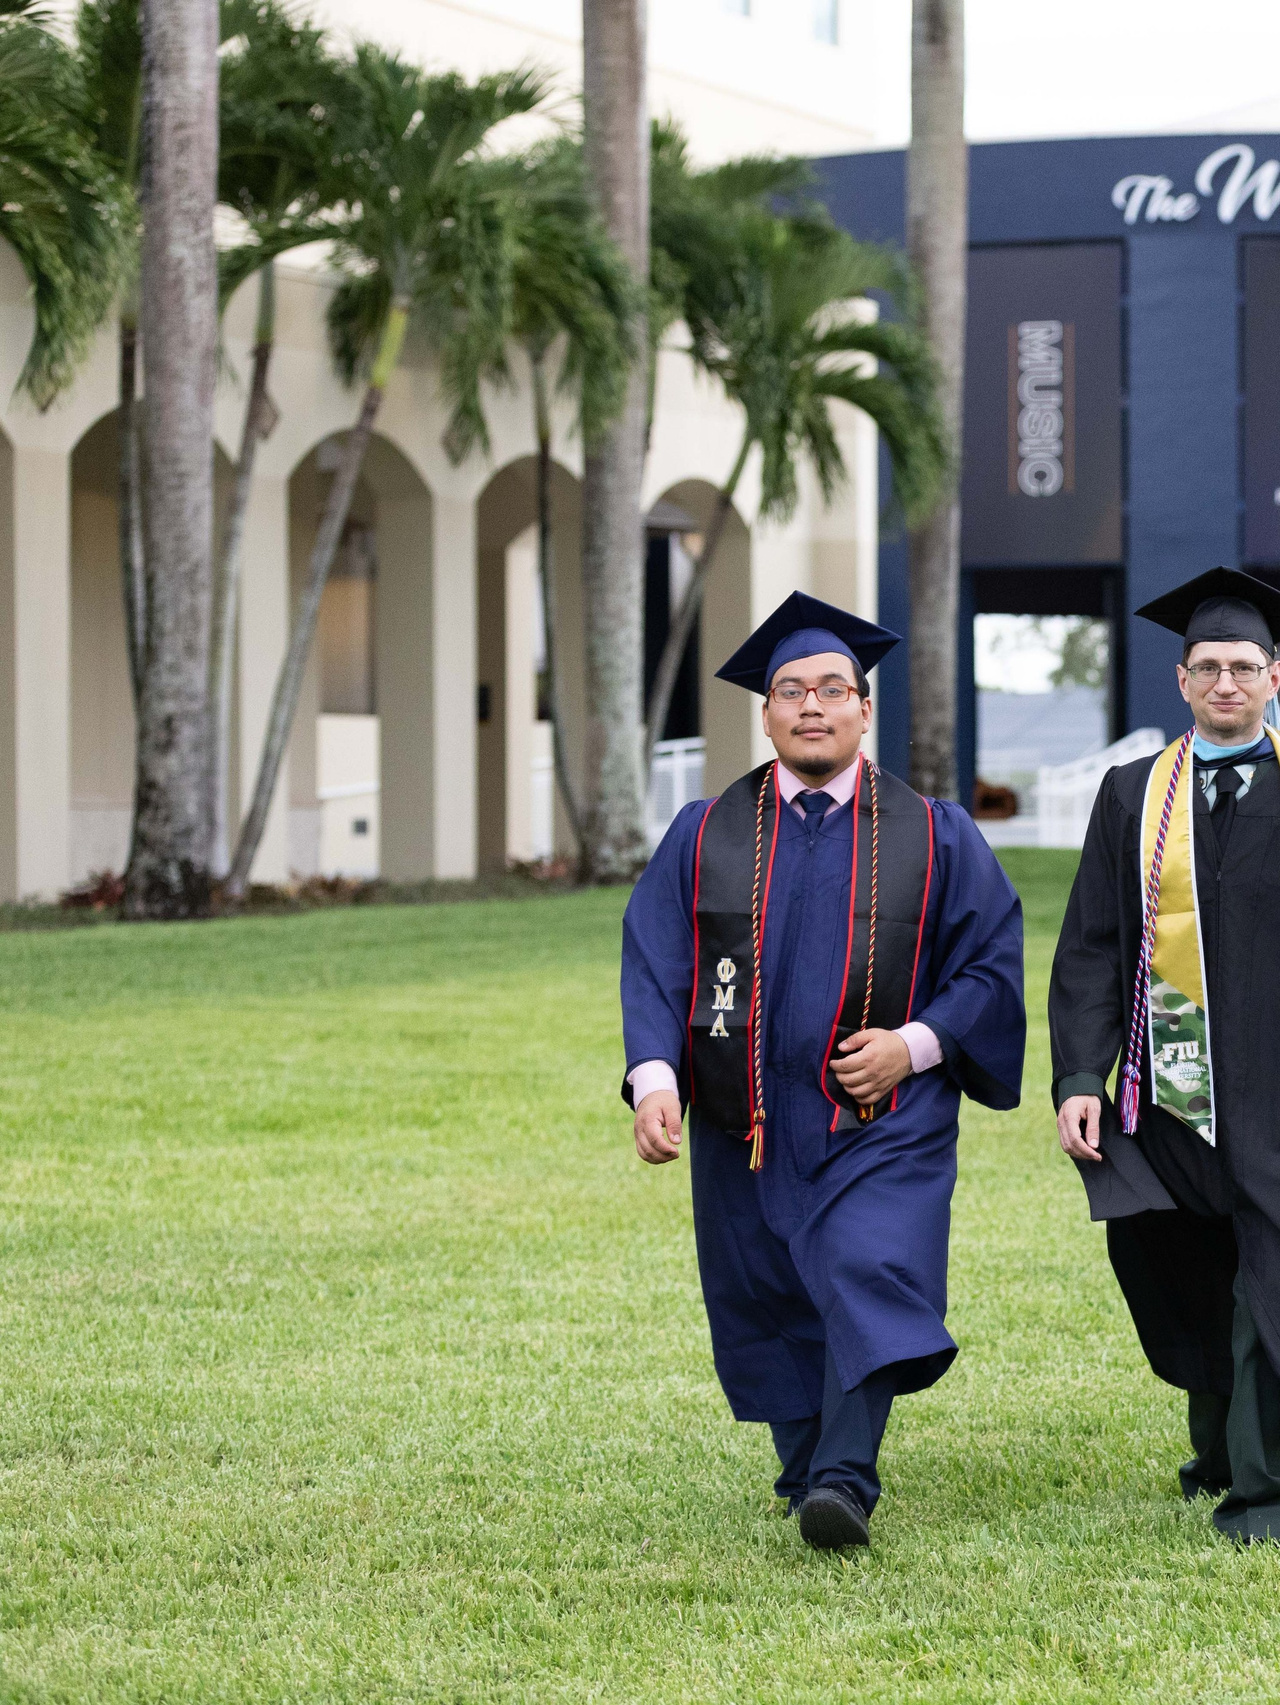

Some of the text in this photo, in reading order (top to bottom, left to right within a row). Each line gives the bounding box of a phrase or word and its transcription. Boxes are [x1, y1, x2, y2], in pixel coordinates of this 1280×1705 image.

[1111, 174, 1199, 225] The
[1017, 320, 1063, 497] MUSIC
[1162, 1040, 1199, 1062] FIU
